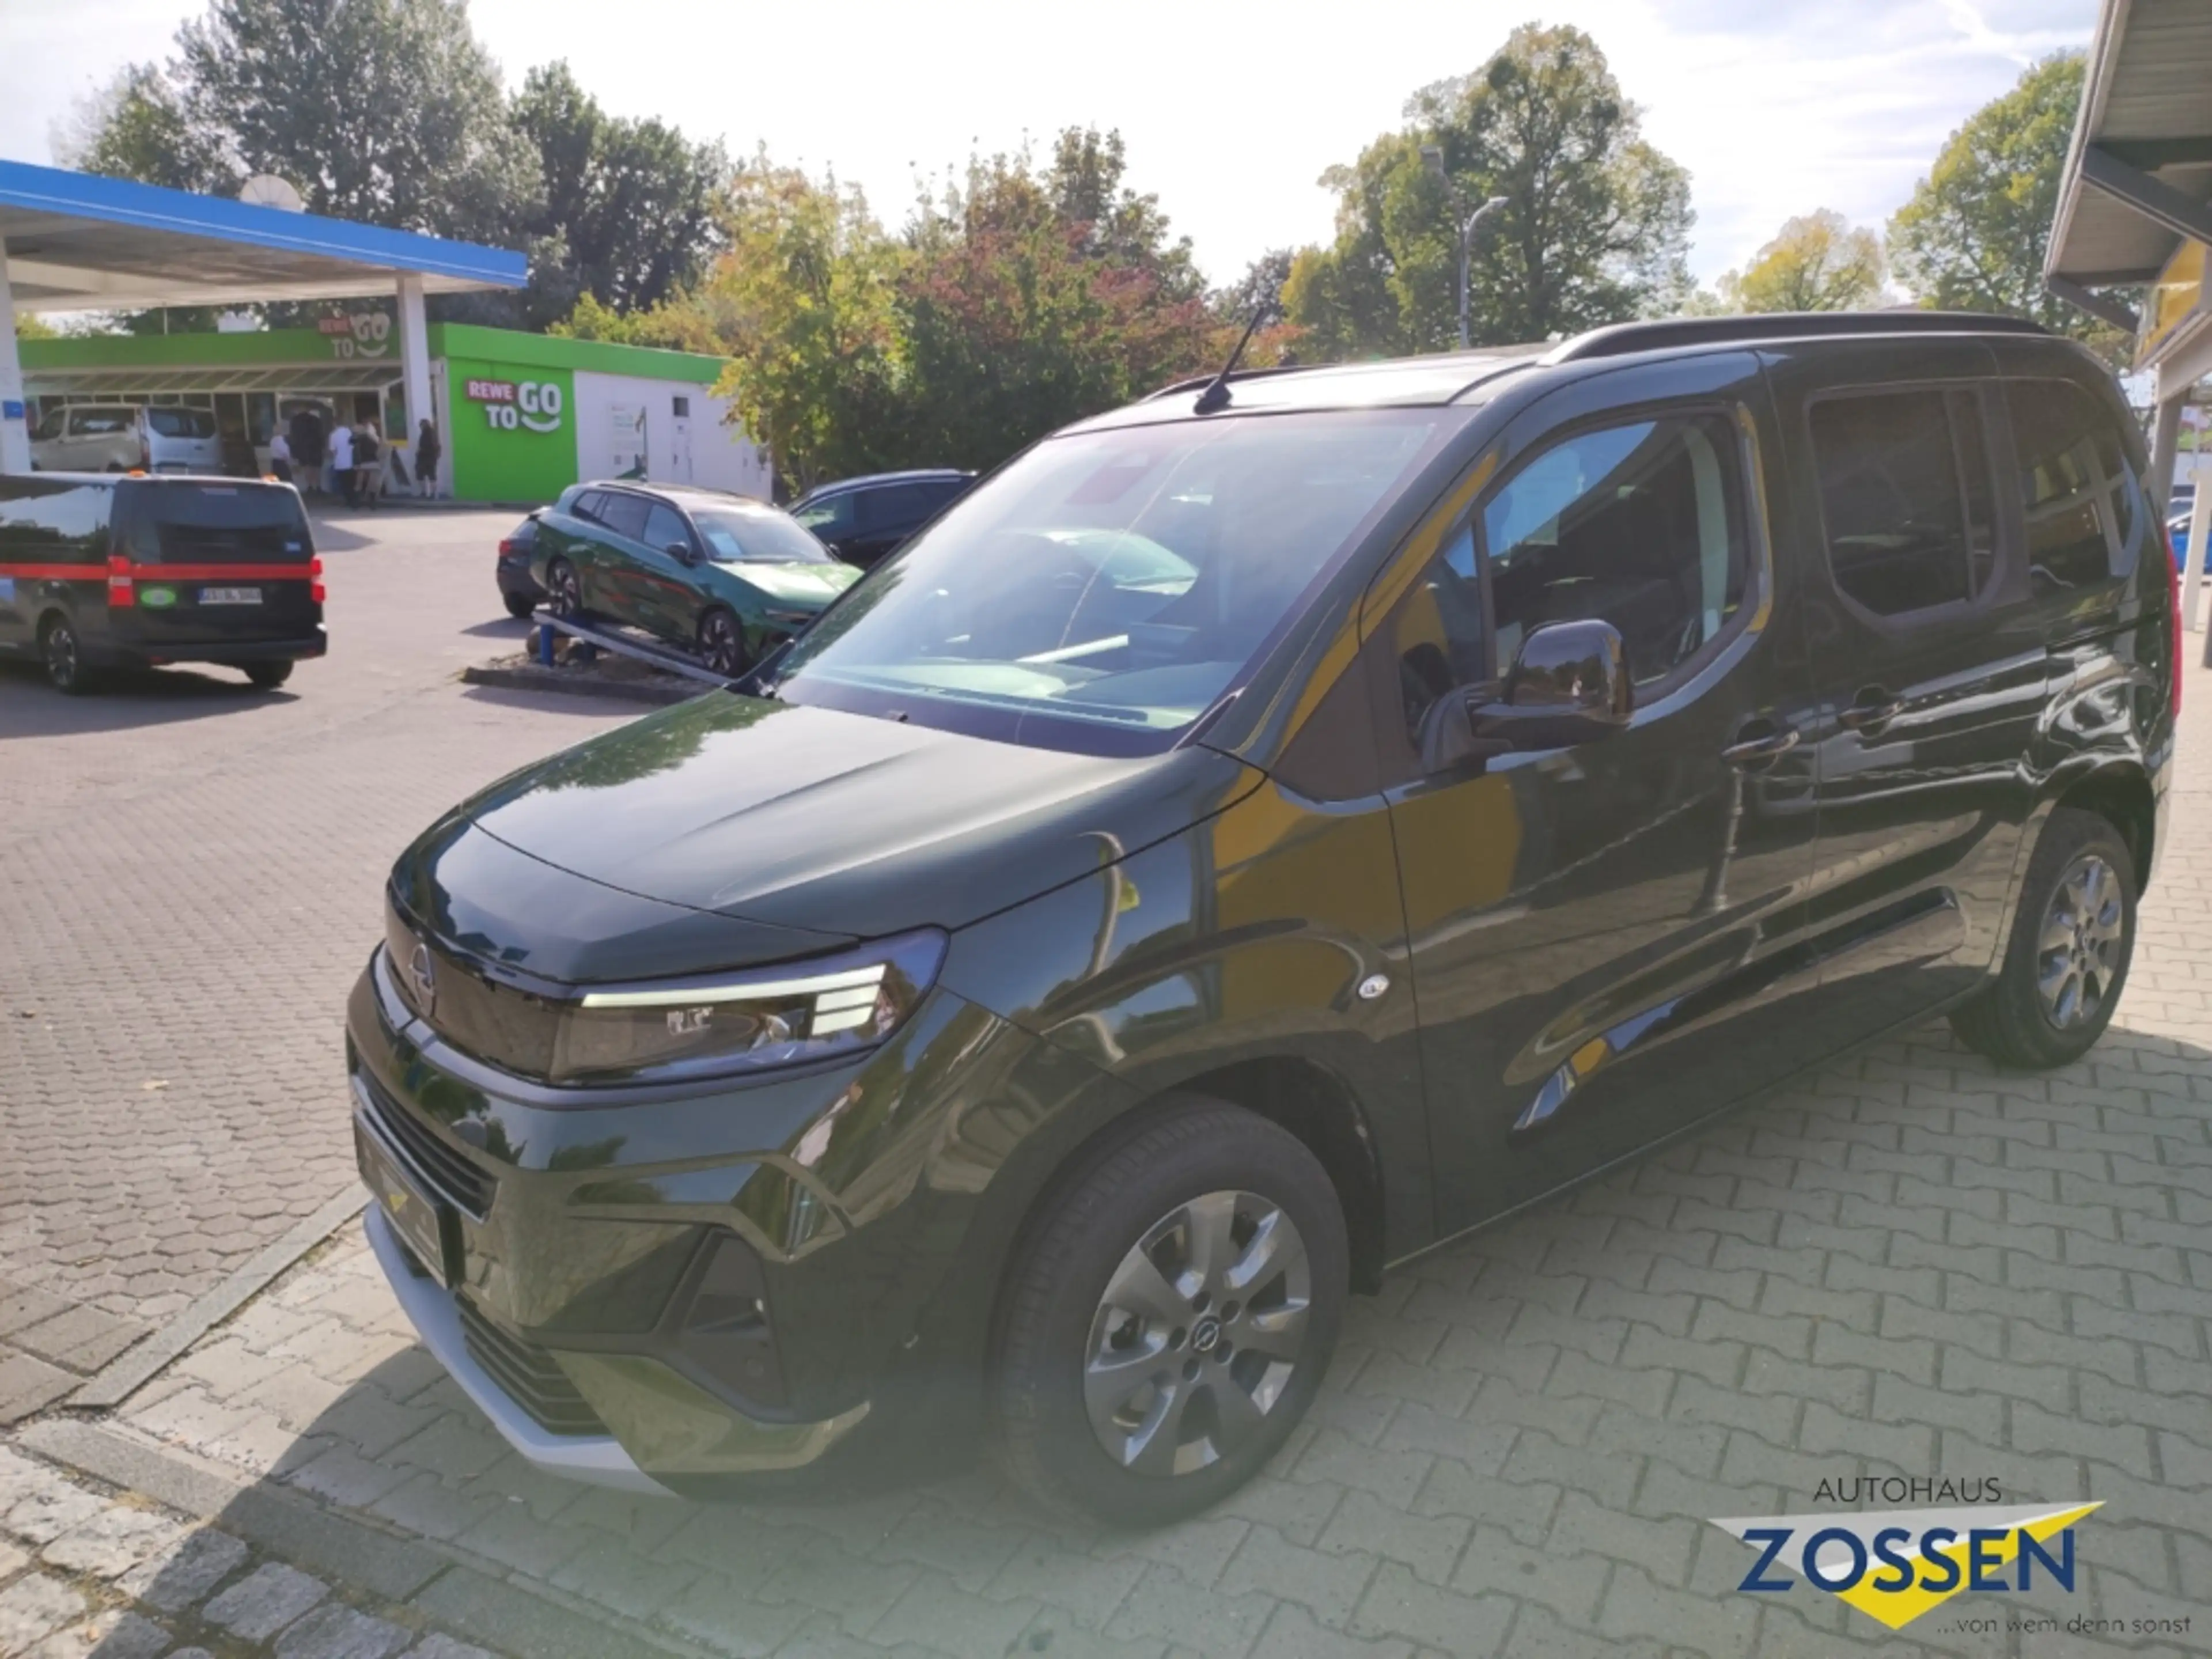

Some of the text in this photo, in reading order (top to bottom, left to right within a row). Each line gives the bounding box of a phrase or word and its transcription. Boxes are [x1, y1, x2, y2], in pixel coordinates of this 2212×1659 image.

[331, 312, 391, 359] TO GO
[468, 380, 513, 400] REWE
[486, 382, 562, 430] TO GO
